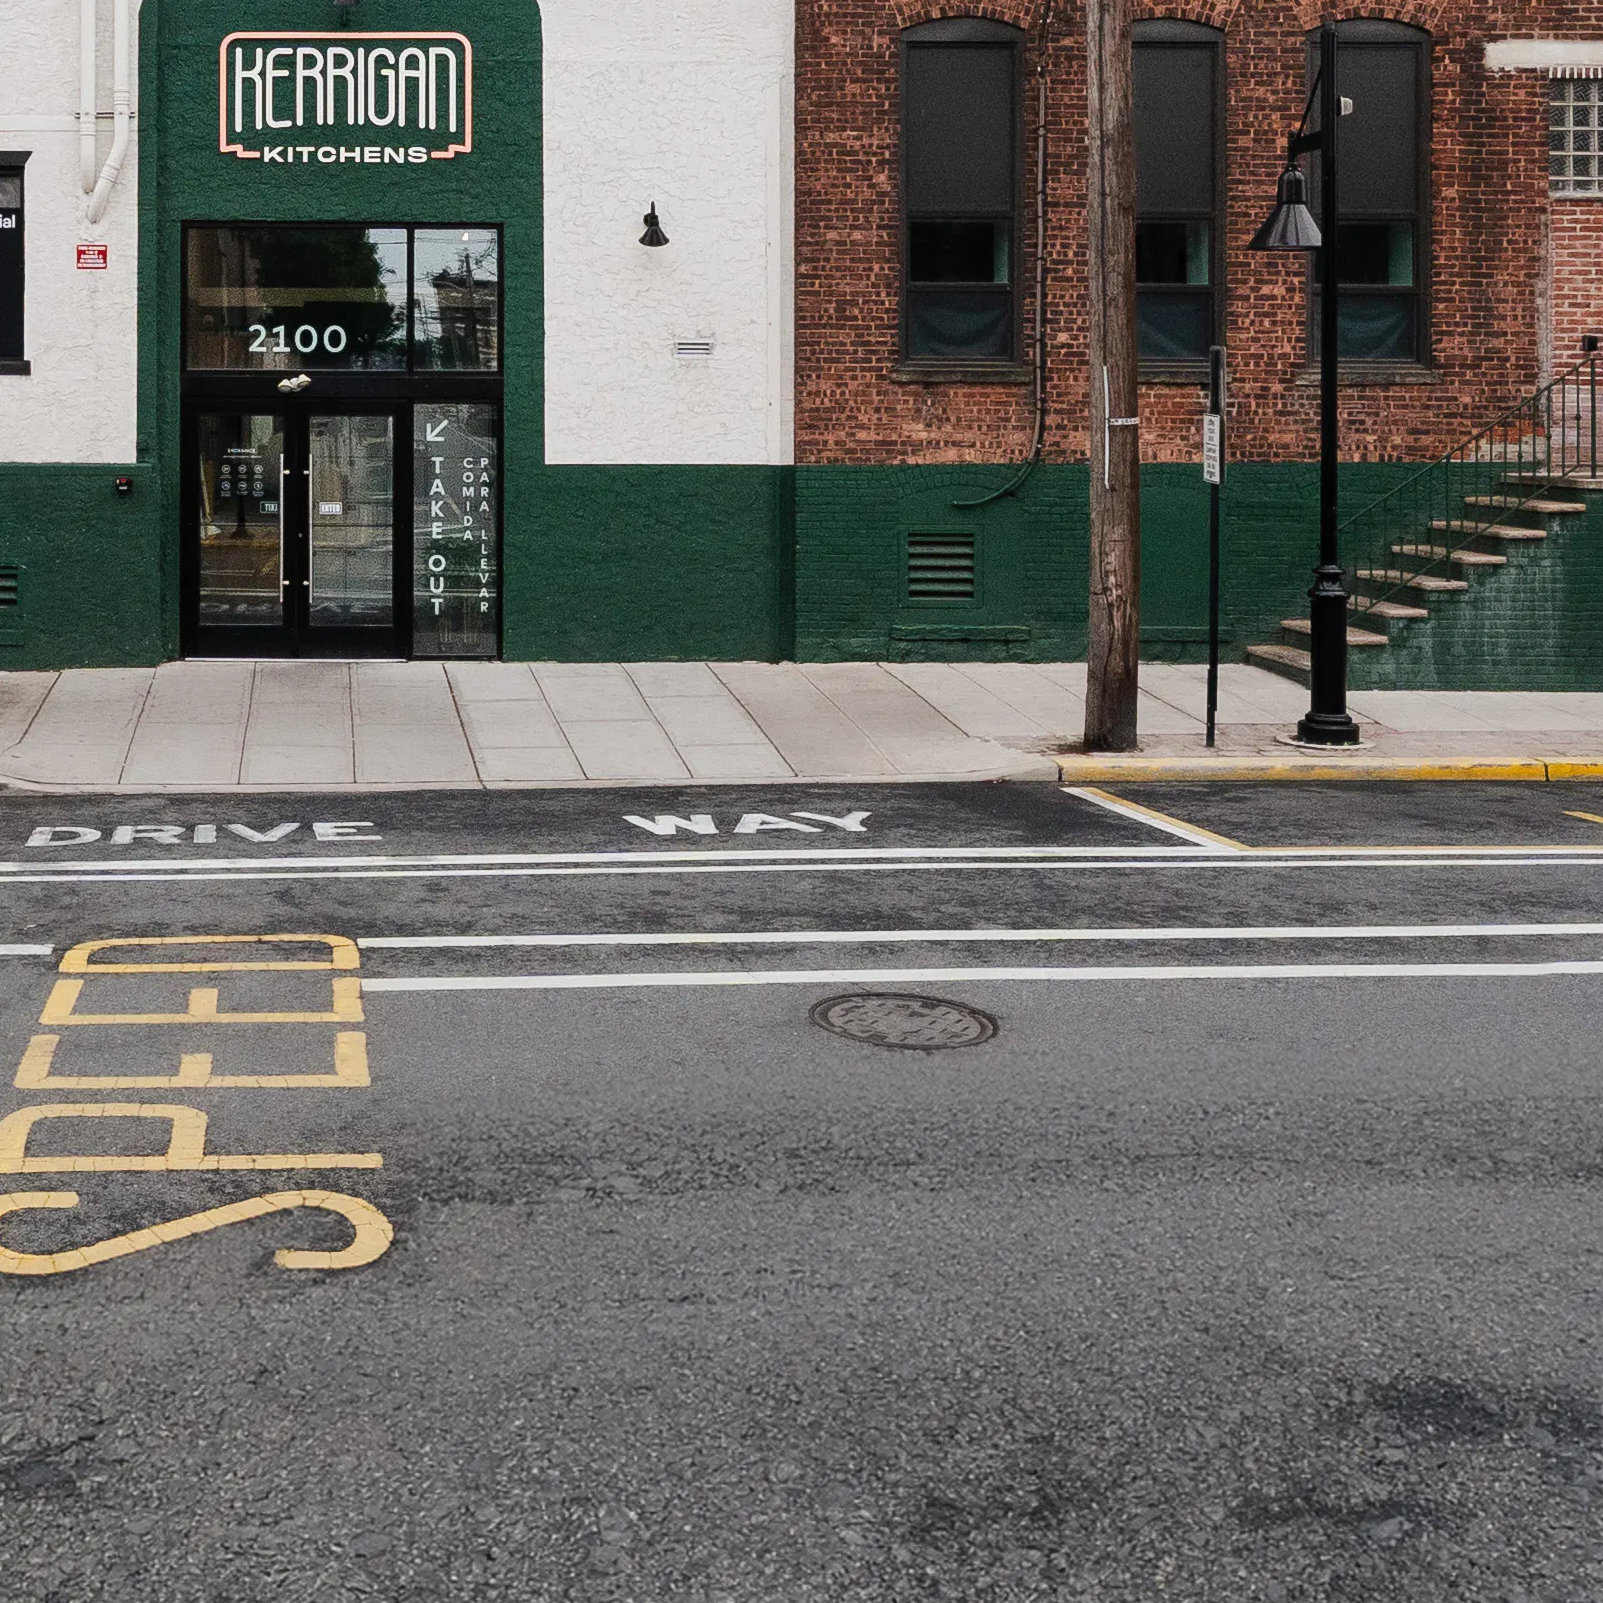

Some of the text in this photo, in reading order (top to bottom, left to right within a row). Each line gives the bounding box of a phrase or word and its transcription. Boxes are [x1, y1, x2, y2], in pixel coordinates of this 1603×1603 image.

[234, 46, 457, 134] KERRIGAN
[263, 146, 428, 164] KITCHENS
[248, 324, 347, 353] 2100
[428, 456, 447, 616] TAKE OUT
[462, 457, 475, 541] COMIDA
[479, 457, 490, 614] PARA LLEVAR
[24, 811, 872, 847] DRIVE WAY
